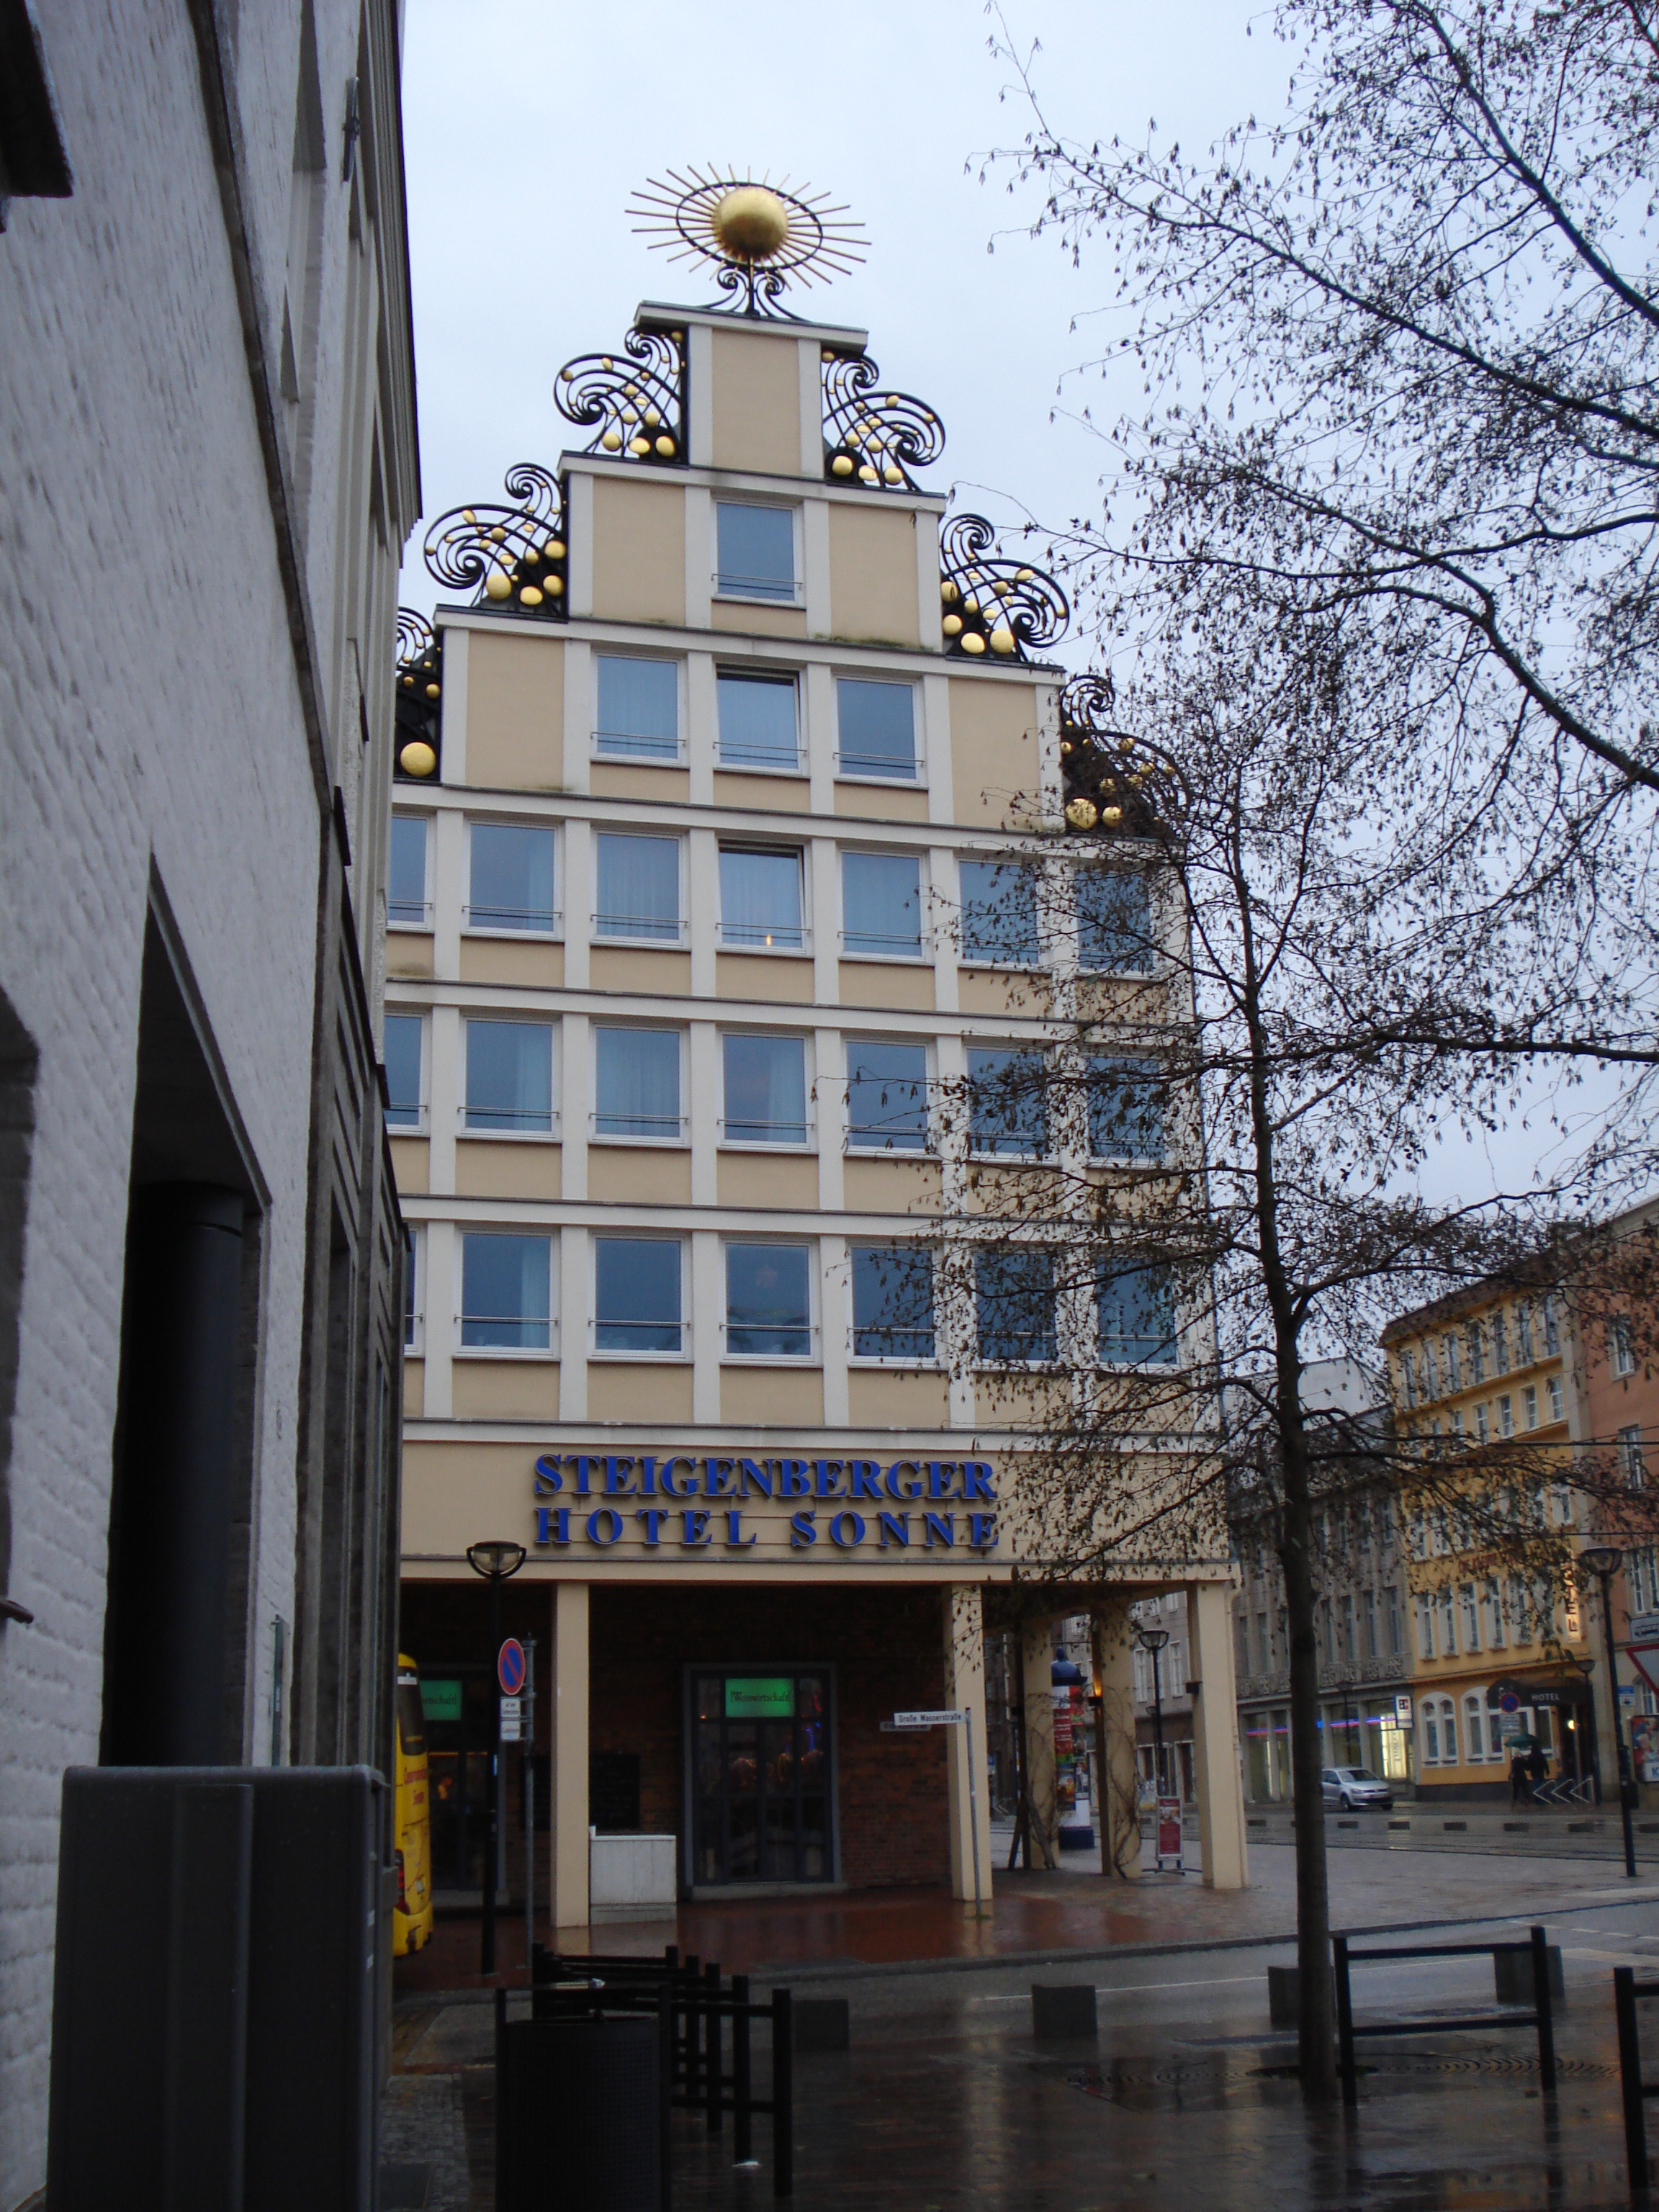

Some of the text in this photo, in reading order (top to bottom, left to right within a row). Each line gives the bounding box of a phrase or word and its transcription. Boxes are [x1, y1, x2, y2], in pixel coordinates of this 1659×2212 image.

[535, 1454, 998, 1499] STEIGENBERGER
[534, 1507, 999, 1547] HOTEL SONNE
[899, 1714, 917, 1723] Große
